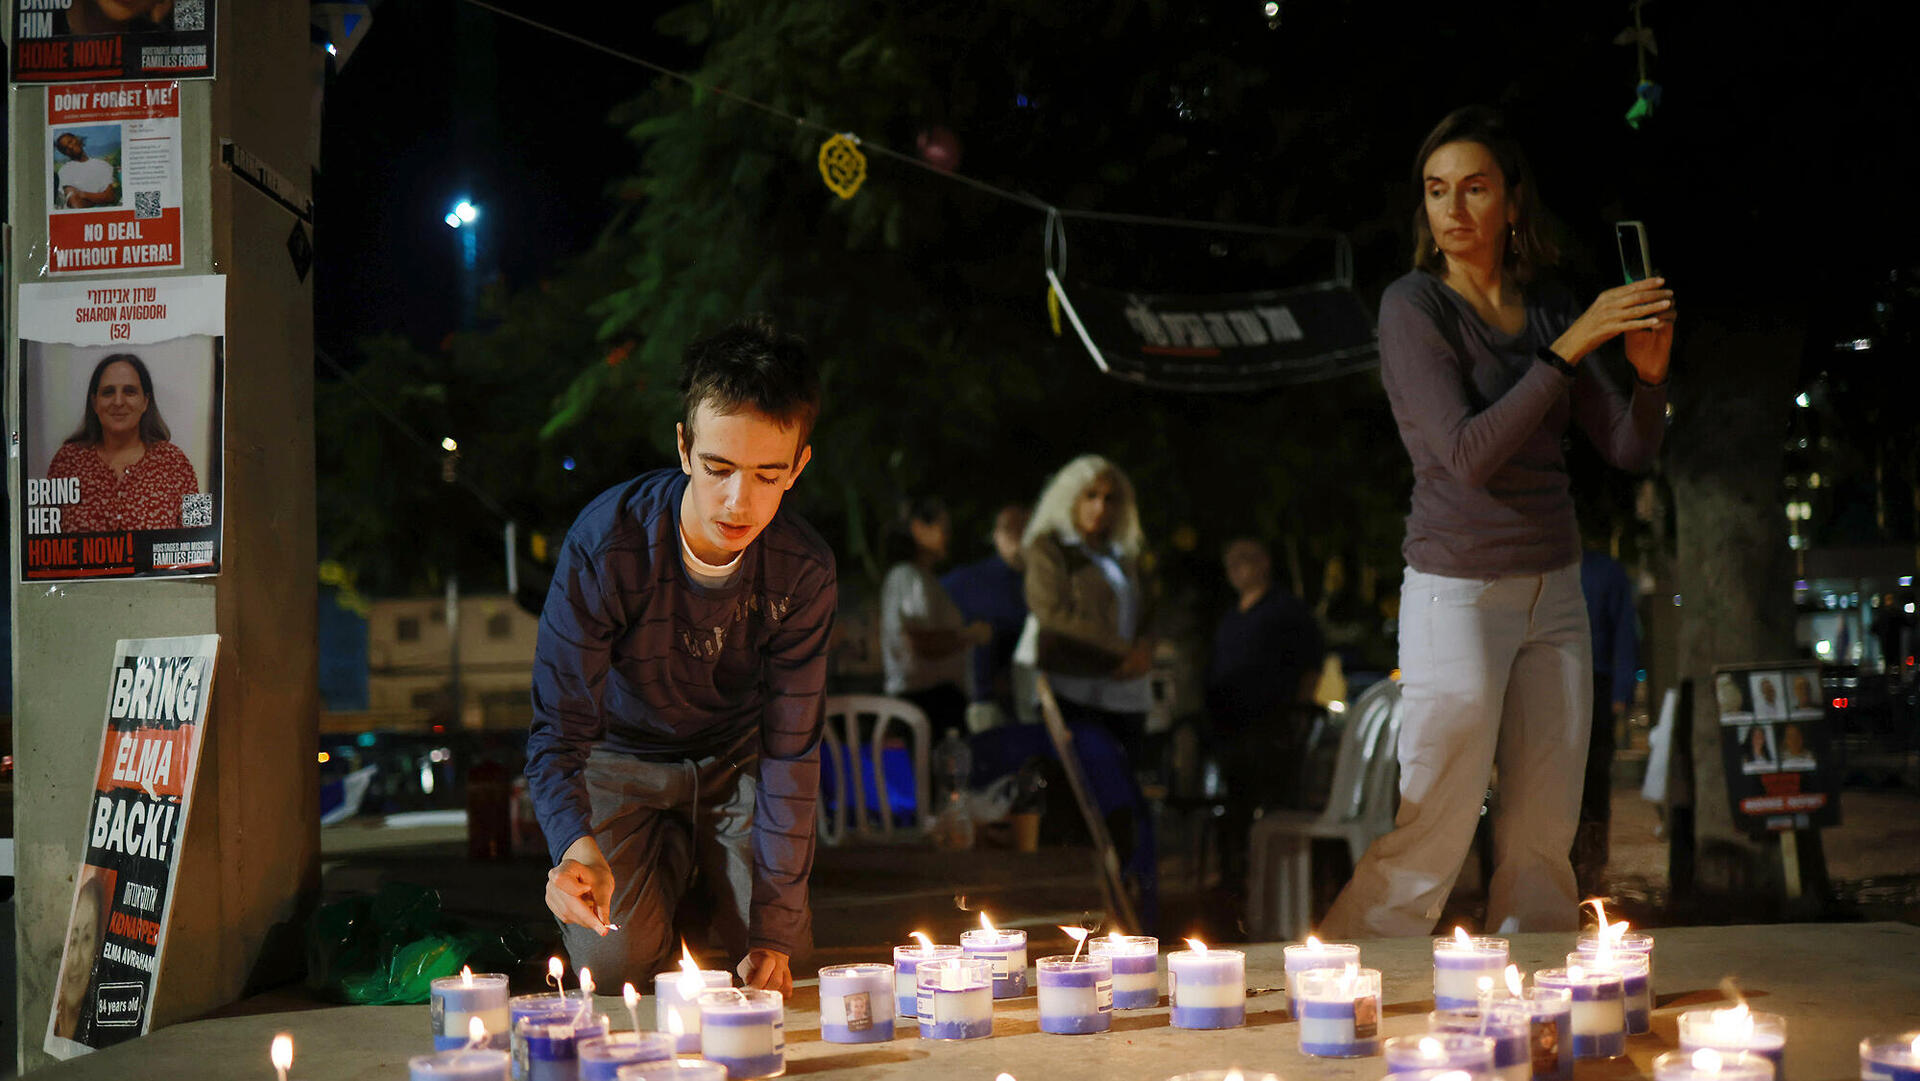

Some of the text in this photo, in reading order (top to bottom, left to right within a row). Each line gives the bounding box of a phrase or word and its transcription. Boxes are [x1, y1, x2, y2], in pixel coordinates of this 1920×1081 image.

[19, 12, 53, 39] HIM
[18, 35, 123, 69] HOME NOW!
[141, 53, 207, 68] FAMILIES FORUM
[54, 87, 172, 112] DONT FORGET ME!
[84, 221, 143, 242] NO DEAL
[55, 243, 173, 268] WITHOUT AVERA!
[133, 287, 156, 304] שרון
[76, 304, 167, 323] SHARON AVIGDORI
[110, 322, 131, 340] (52)
[27, 477, 80, 506] BRING
[28, 507, 62, 535] HER
[28, 532, 134, 566] HOME NOW!
[152, 550, 214, 566] FAMILIES FORUM
[111, 662, 199, 723] BRING
[112, 735, 173, 788] ELMA
[91, 795, 175, 862] BACK!
[103, 941, 122, 963] ELMA
[98, 996, 139, 1016] 84 years old
